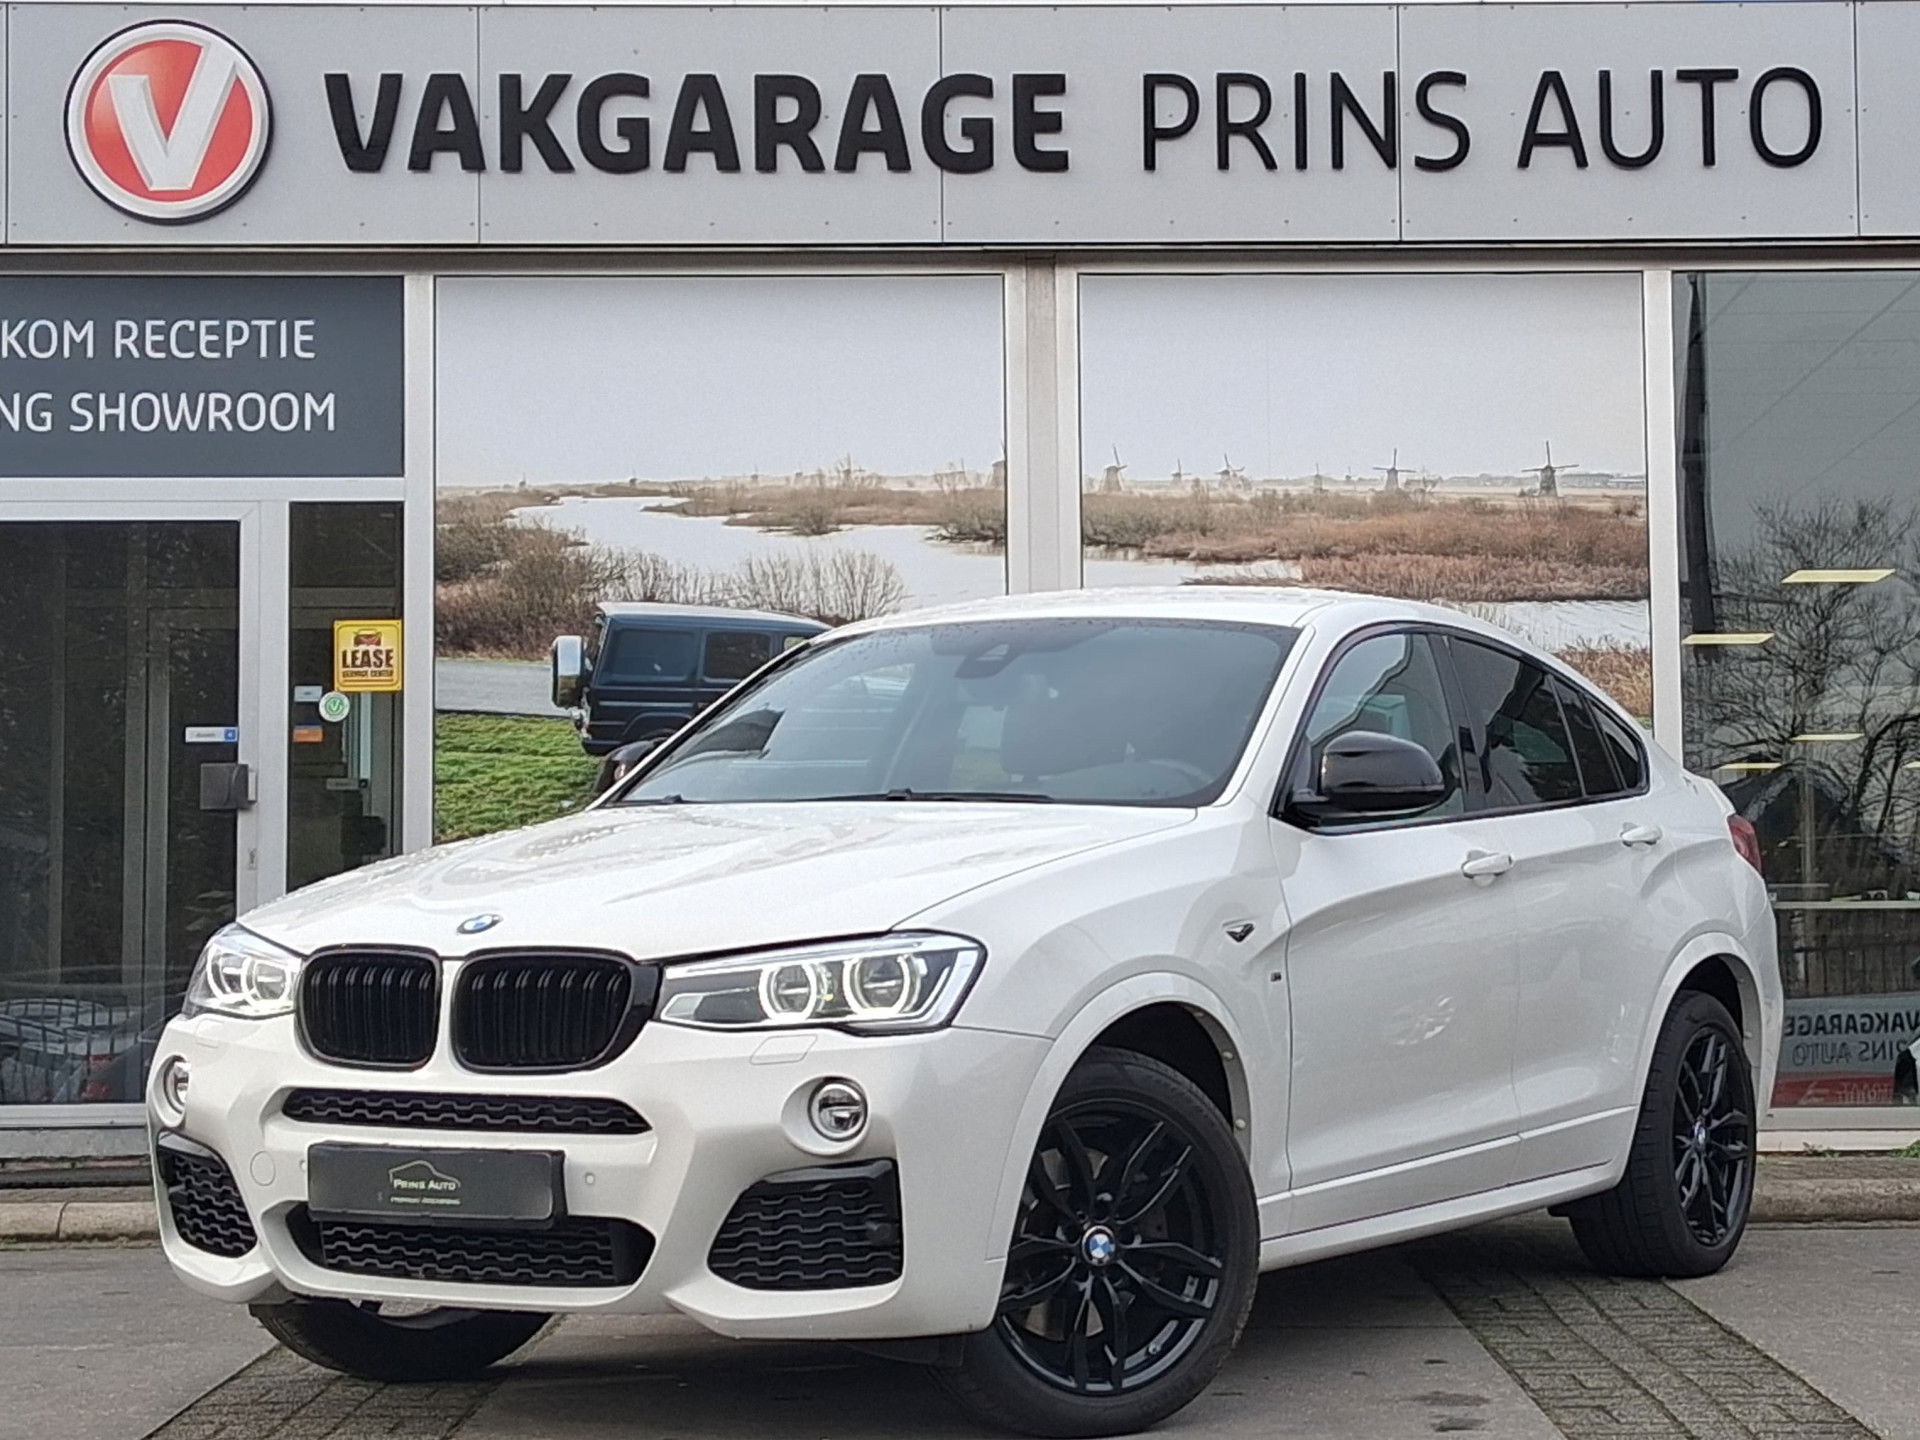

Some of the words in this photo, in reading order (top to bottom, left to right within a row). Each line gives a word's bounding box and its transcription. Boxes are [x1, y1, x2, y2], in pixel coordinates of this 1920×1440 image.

[324, 73, 1070, 175] VAKGARAGE
[1143, 70, 1471, 174] PRINS
[1517, 67, 1823, 171] AUTO
[0, 319, 94, 359] KOM
[115, 319, 315, 359] RECEPTIE
[69, 392, 335, 432] SHOWROOM
[341, 648, 394, 669] LEASE
[428, 1180, 457, 1191] AUTO
